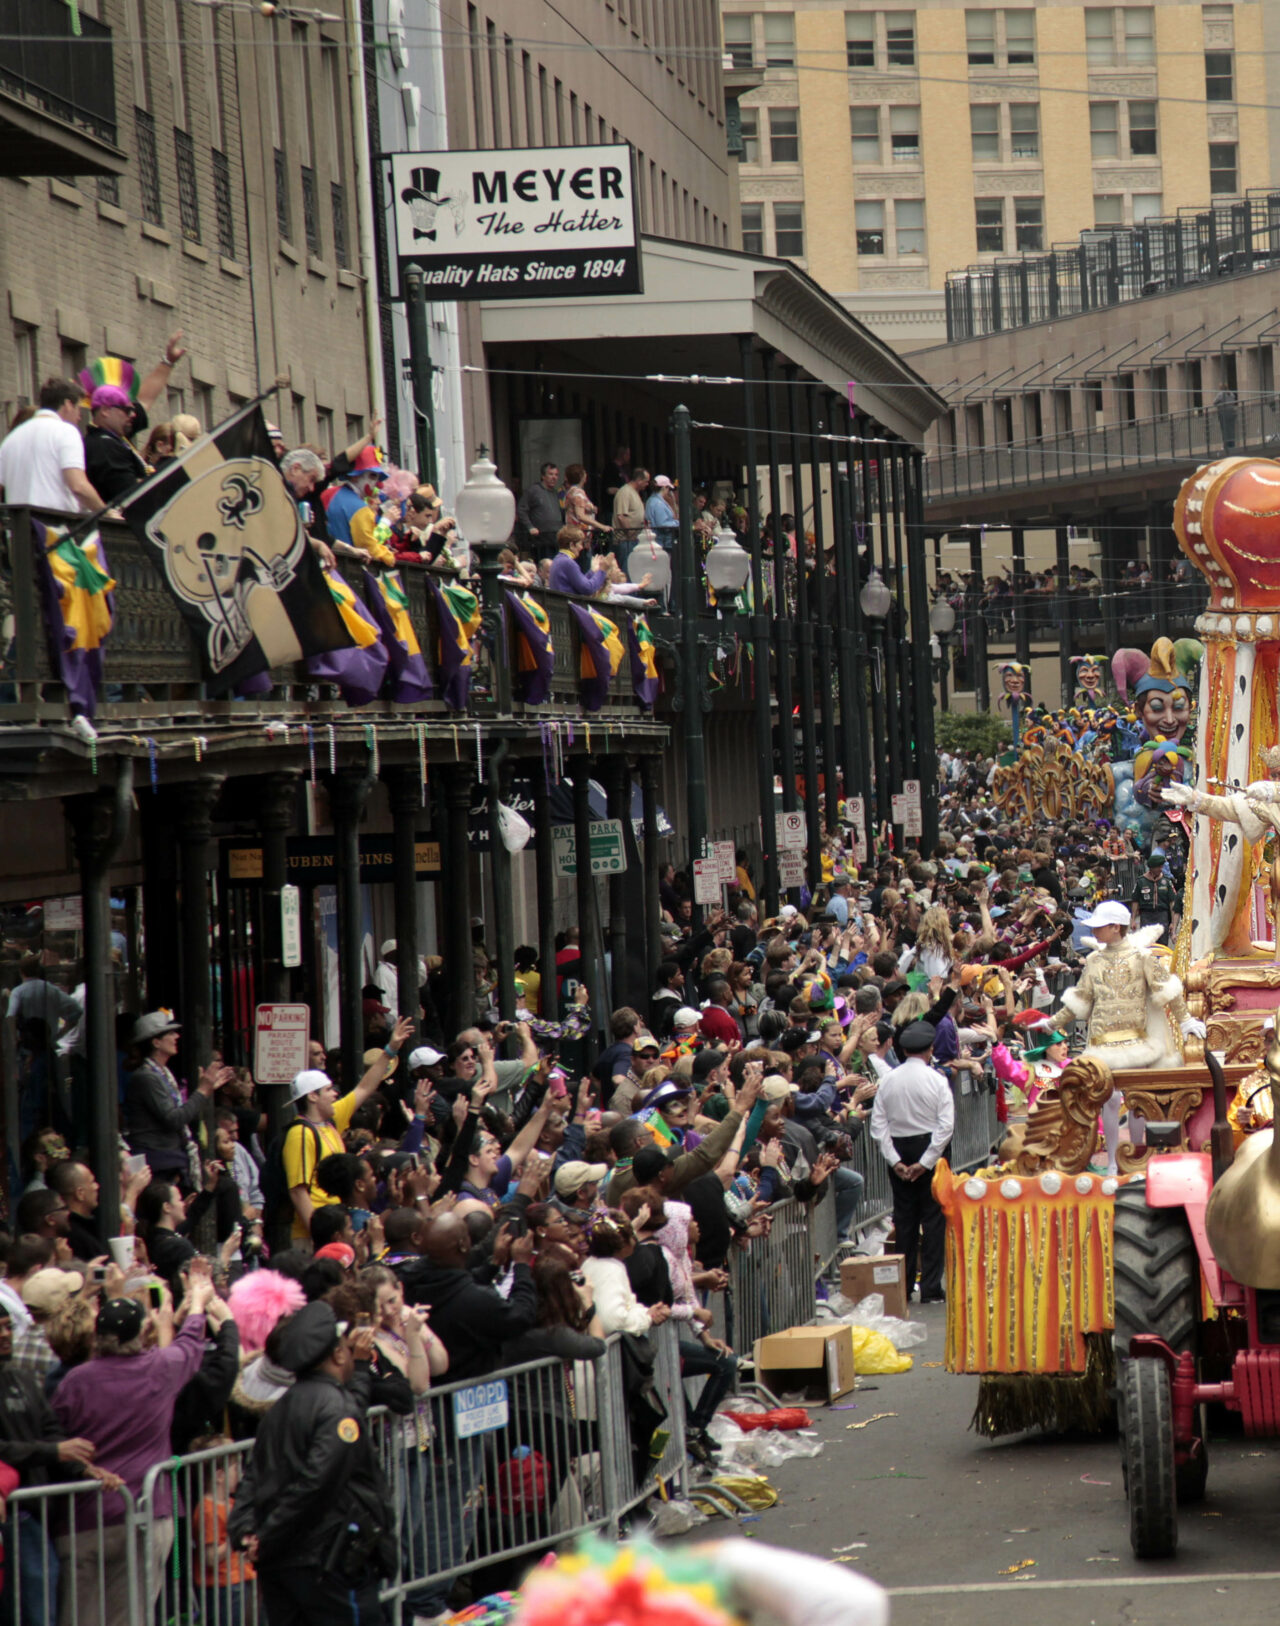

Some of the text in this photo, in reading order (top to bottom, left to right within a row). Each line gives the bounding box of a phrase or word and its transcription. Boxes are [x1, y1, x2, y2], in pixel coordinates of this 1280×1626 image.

[472, 166, 625, 204] MEYER
[476, 209, 623, 237] The Hatter
[422, 258, 626, 287] uality Hats Since 1894
[554, 823, 618, 837] PAY PARK
[559, 855, 577, 864] HOU
[258, 1010, 305, 1027] NO PARKING
